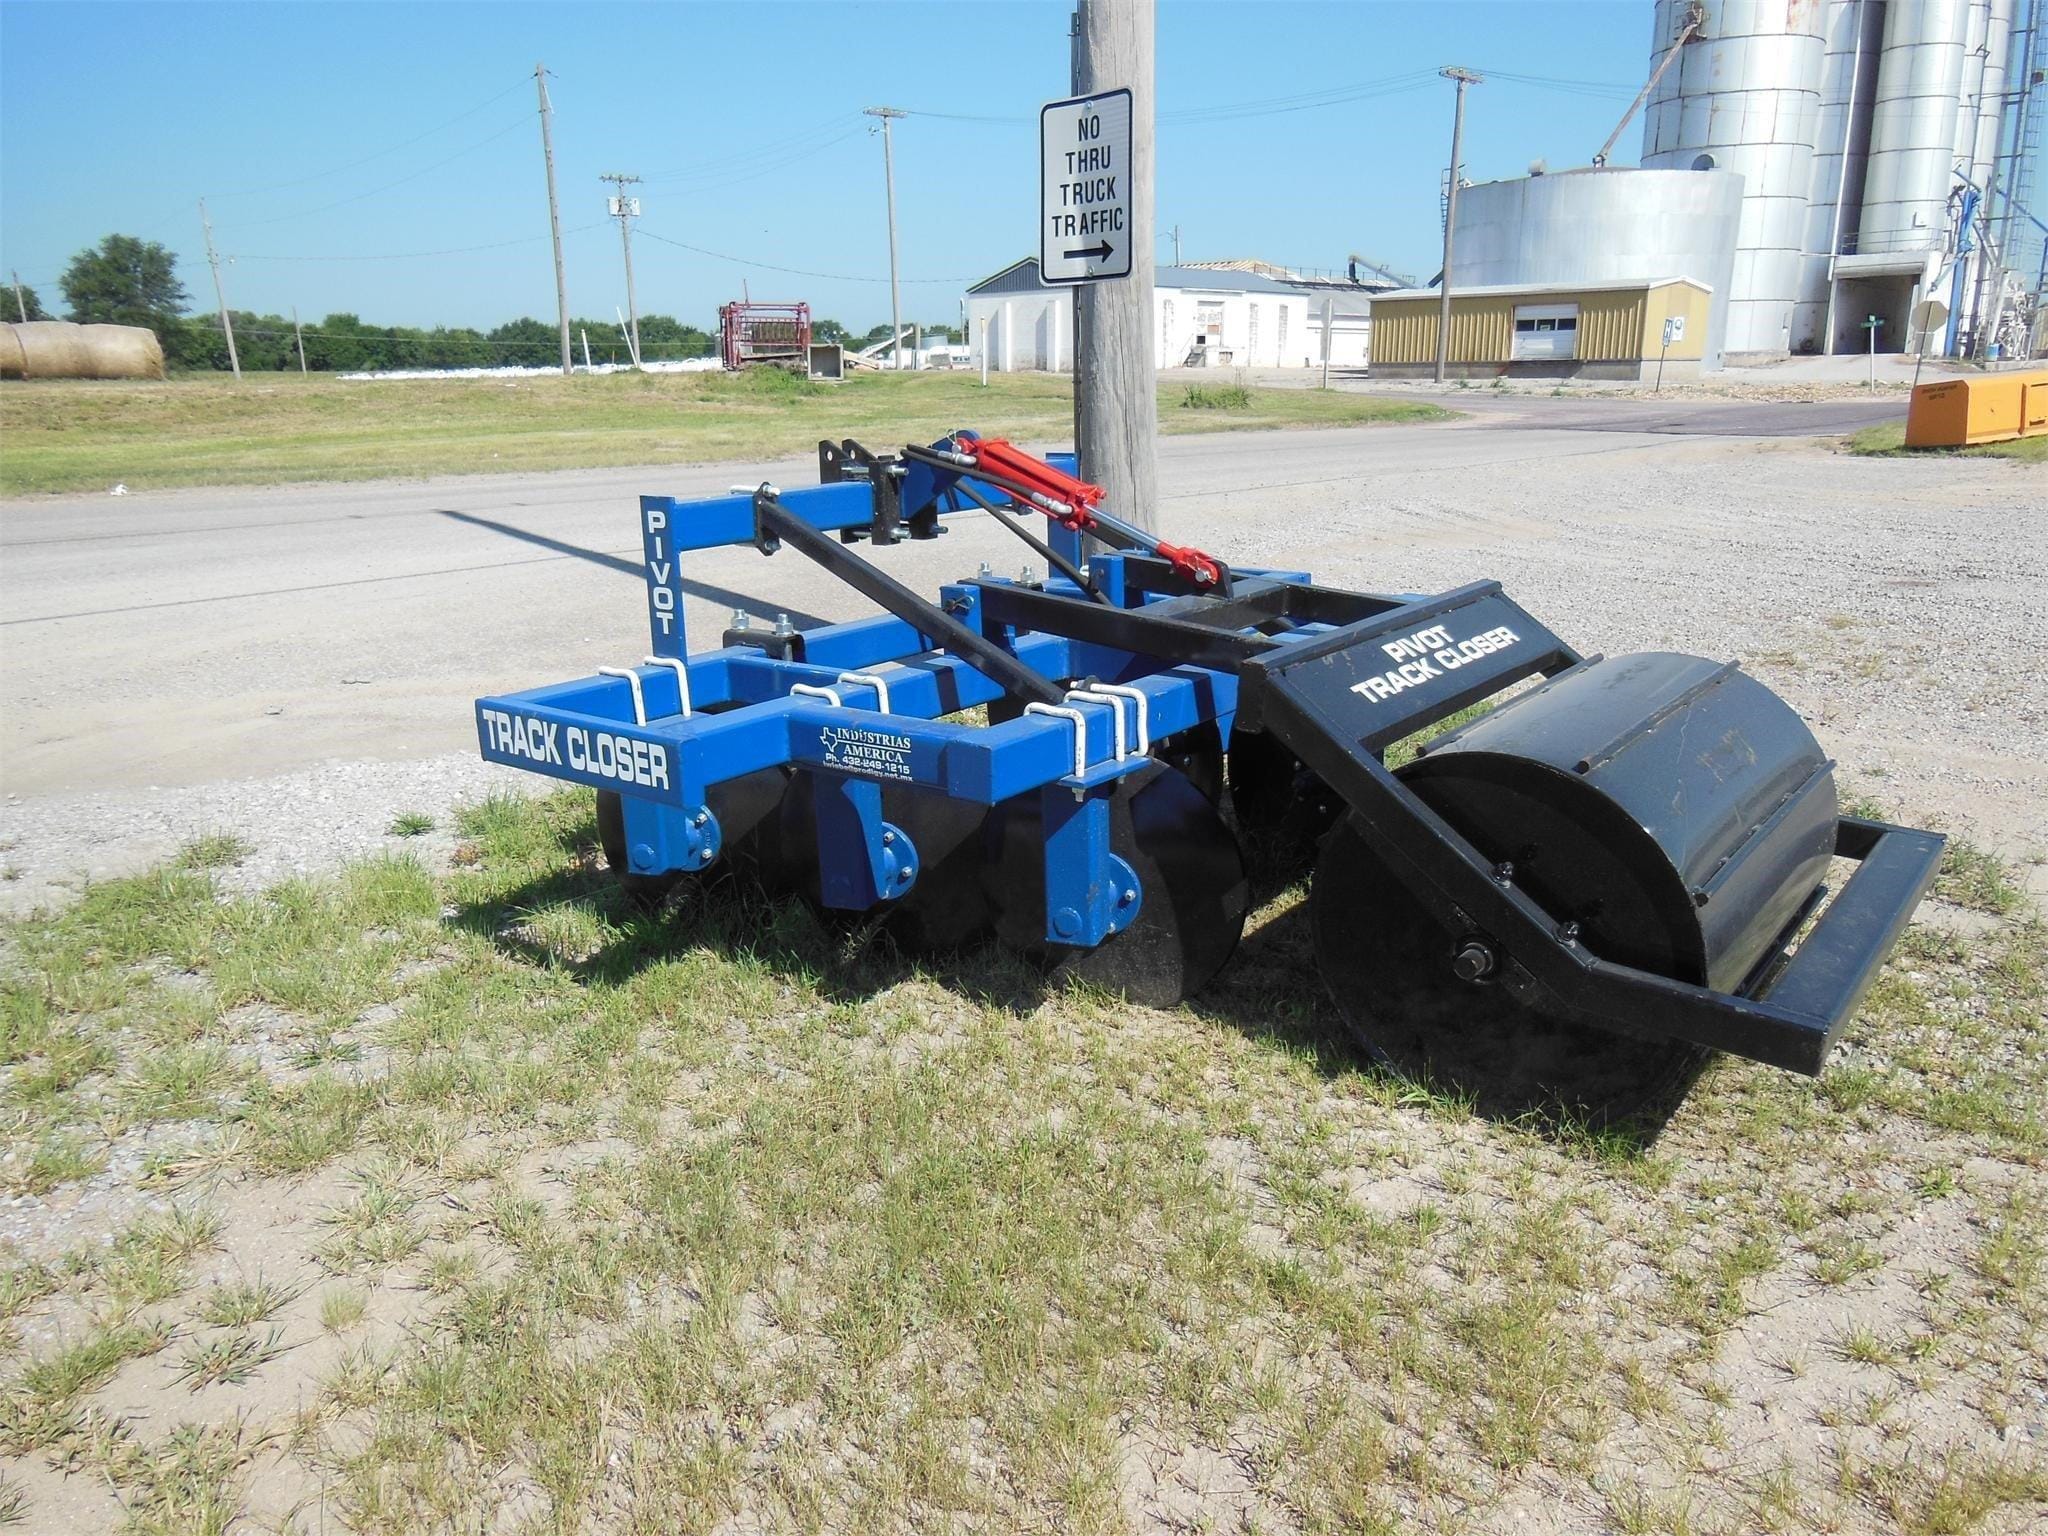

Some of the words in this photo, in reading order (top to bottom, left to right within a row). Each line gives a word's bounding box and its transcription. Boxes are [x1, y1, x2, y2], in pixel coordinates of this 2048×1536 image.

[1078, 115, 1100, 142] NO
[1065, 145, 1111, 175] THRU
[1060, 177, 1116, 206] TRUCK
[1052, 207, 1123, 237] TRAFFIC
[648, 511, 674, 635] PIVOT
[1381, 624, 1455, 663] PIVOT
[1350, 658, 1443, 703] TRACK
[1434, 626, 1520, 670] CLOSER
[482, 709, 563, 765] TRACK
[566, 727, 671, 791] CLOSER
[837, 728, 911, 749] INDUSTRIAS
[844, 744, 904, 763] AMERICA
[825, 752, 840, 763] Ph.
